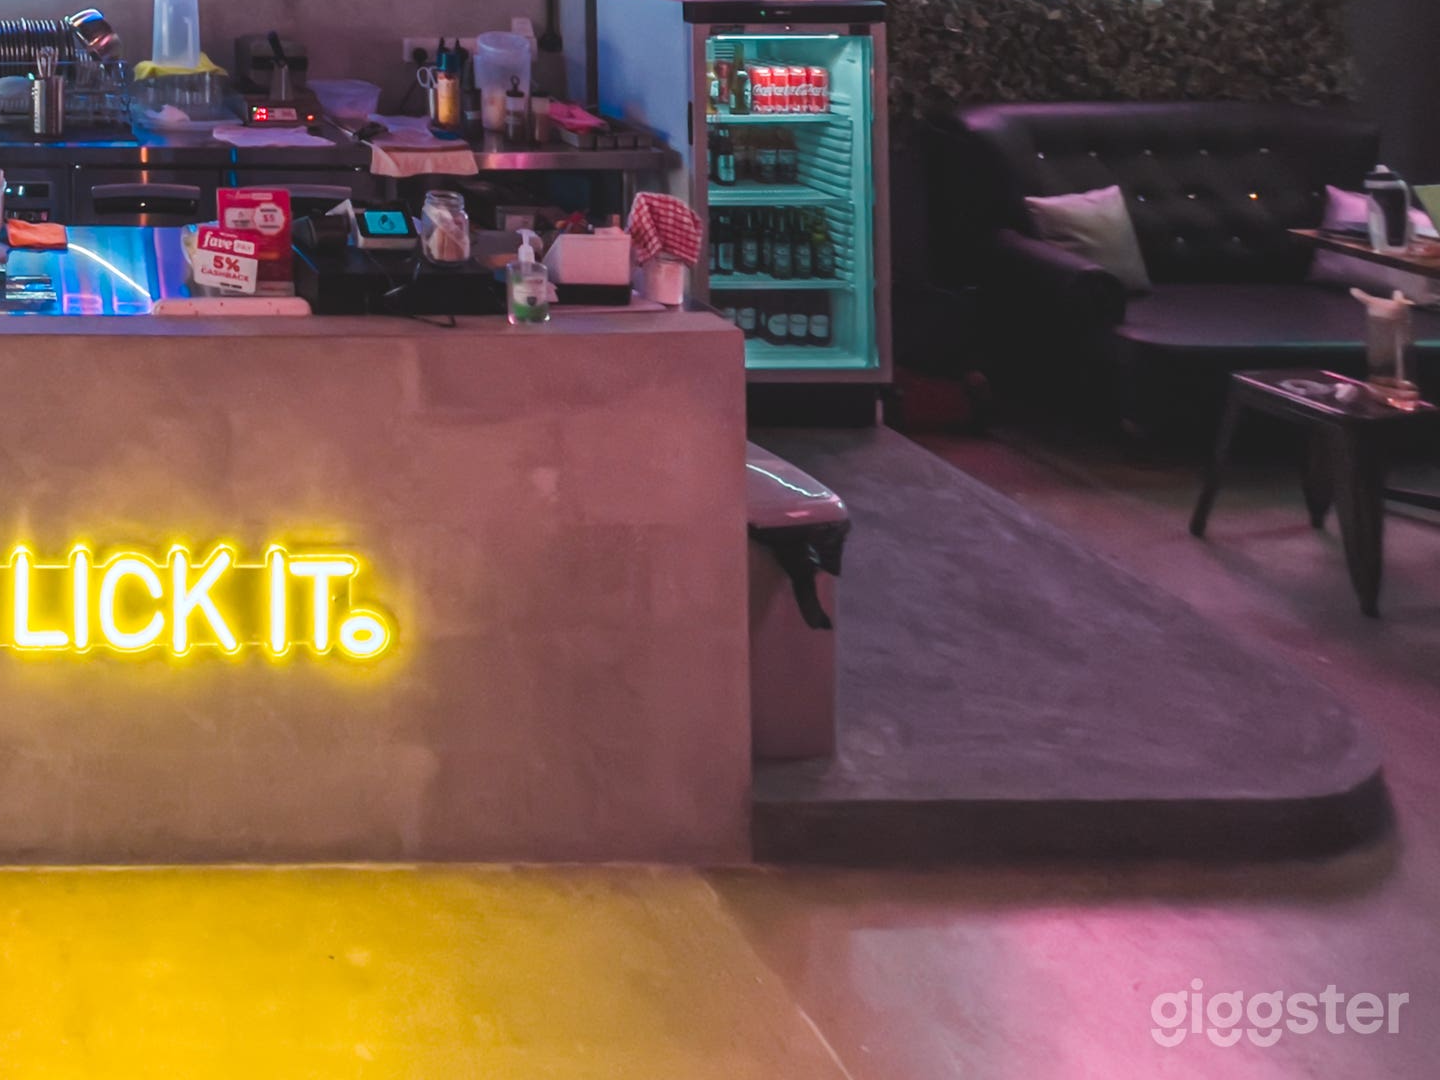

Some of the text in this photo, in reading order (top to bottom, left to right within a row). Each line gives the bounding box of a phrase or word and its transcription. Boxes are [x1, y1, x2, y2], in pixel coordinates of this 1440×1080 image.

[202, 230, 233, 250] fave
[213, 254, 241, 273] 5%
[11, 542, 240, 655] LICK
